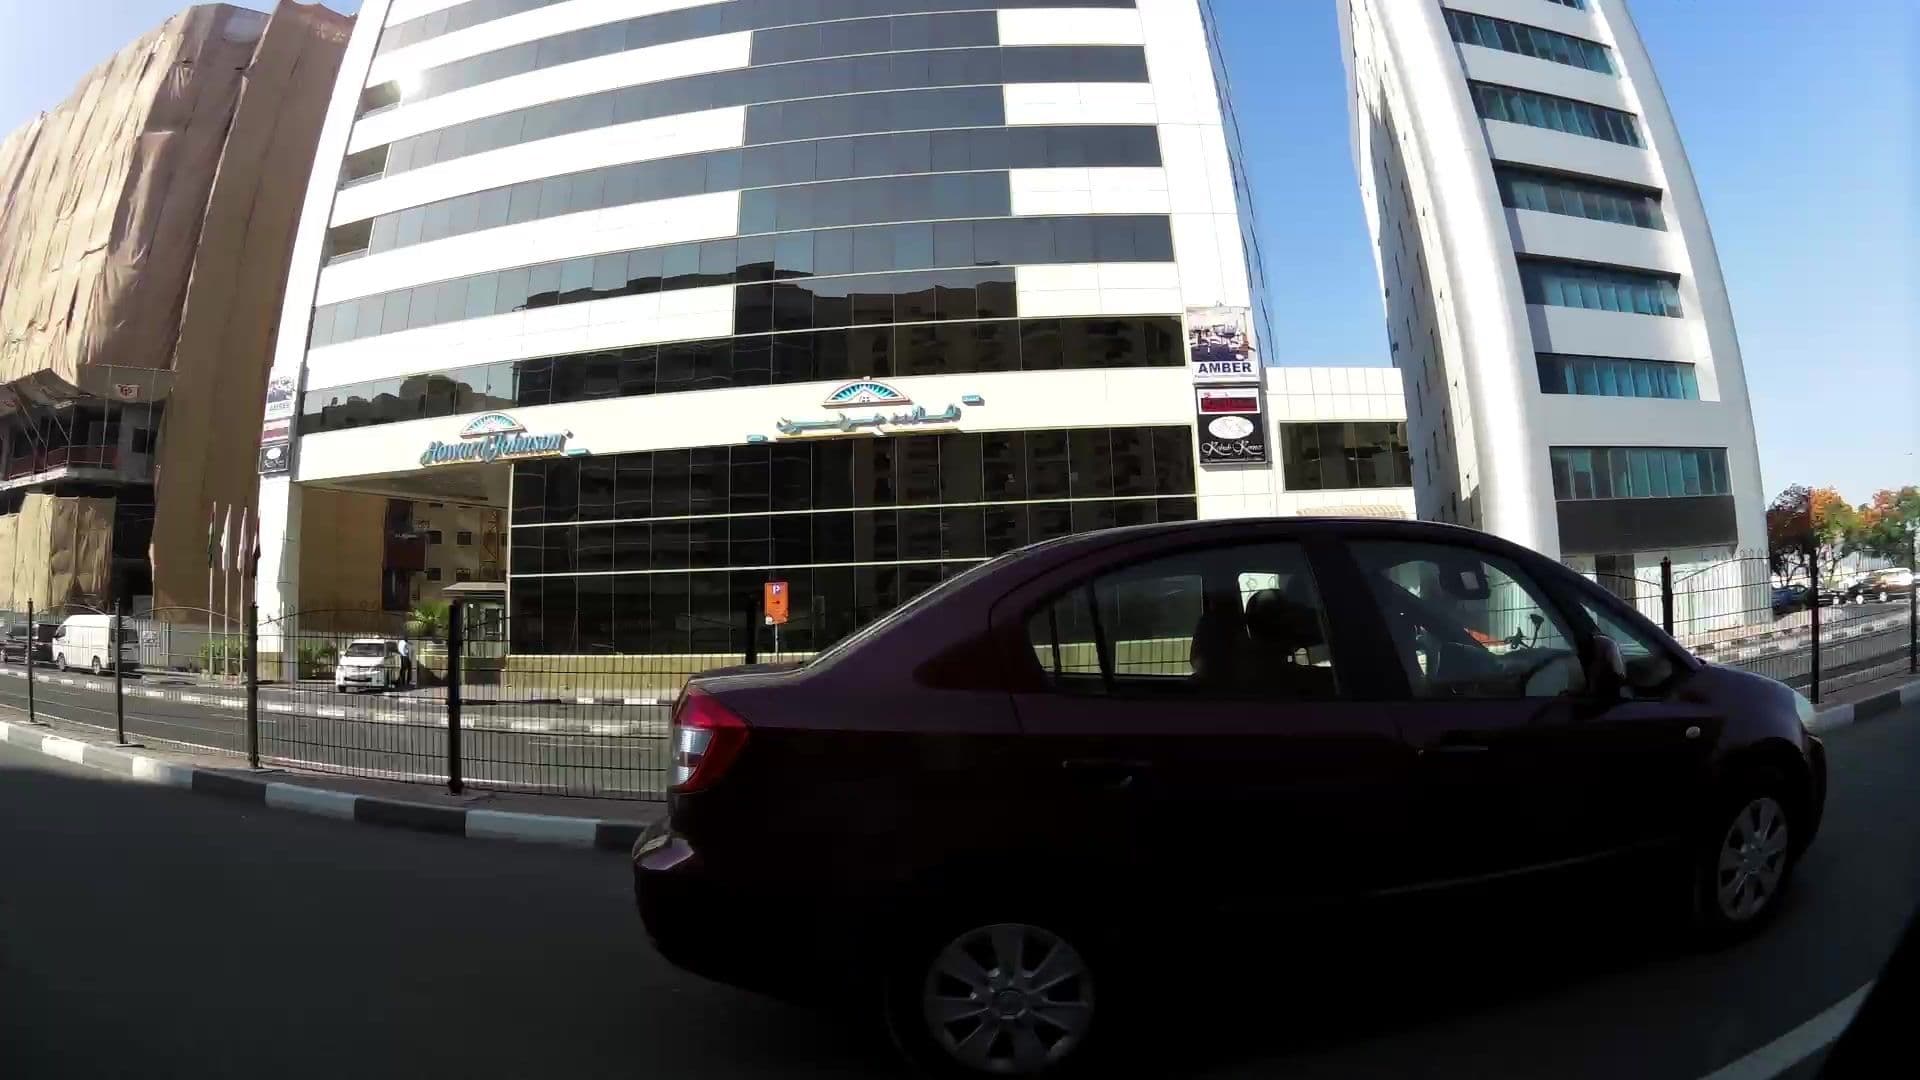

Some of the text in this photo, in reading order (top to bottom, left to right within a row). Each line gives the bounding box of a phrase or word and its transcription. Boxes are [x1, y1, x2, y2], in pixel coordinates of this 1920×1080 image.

[1199, 362, 1252, 373] AMBER
[420, 432, 566, 466] Howard Johnson
[772, 584, 781, 595] P
